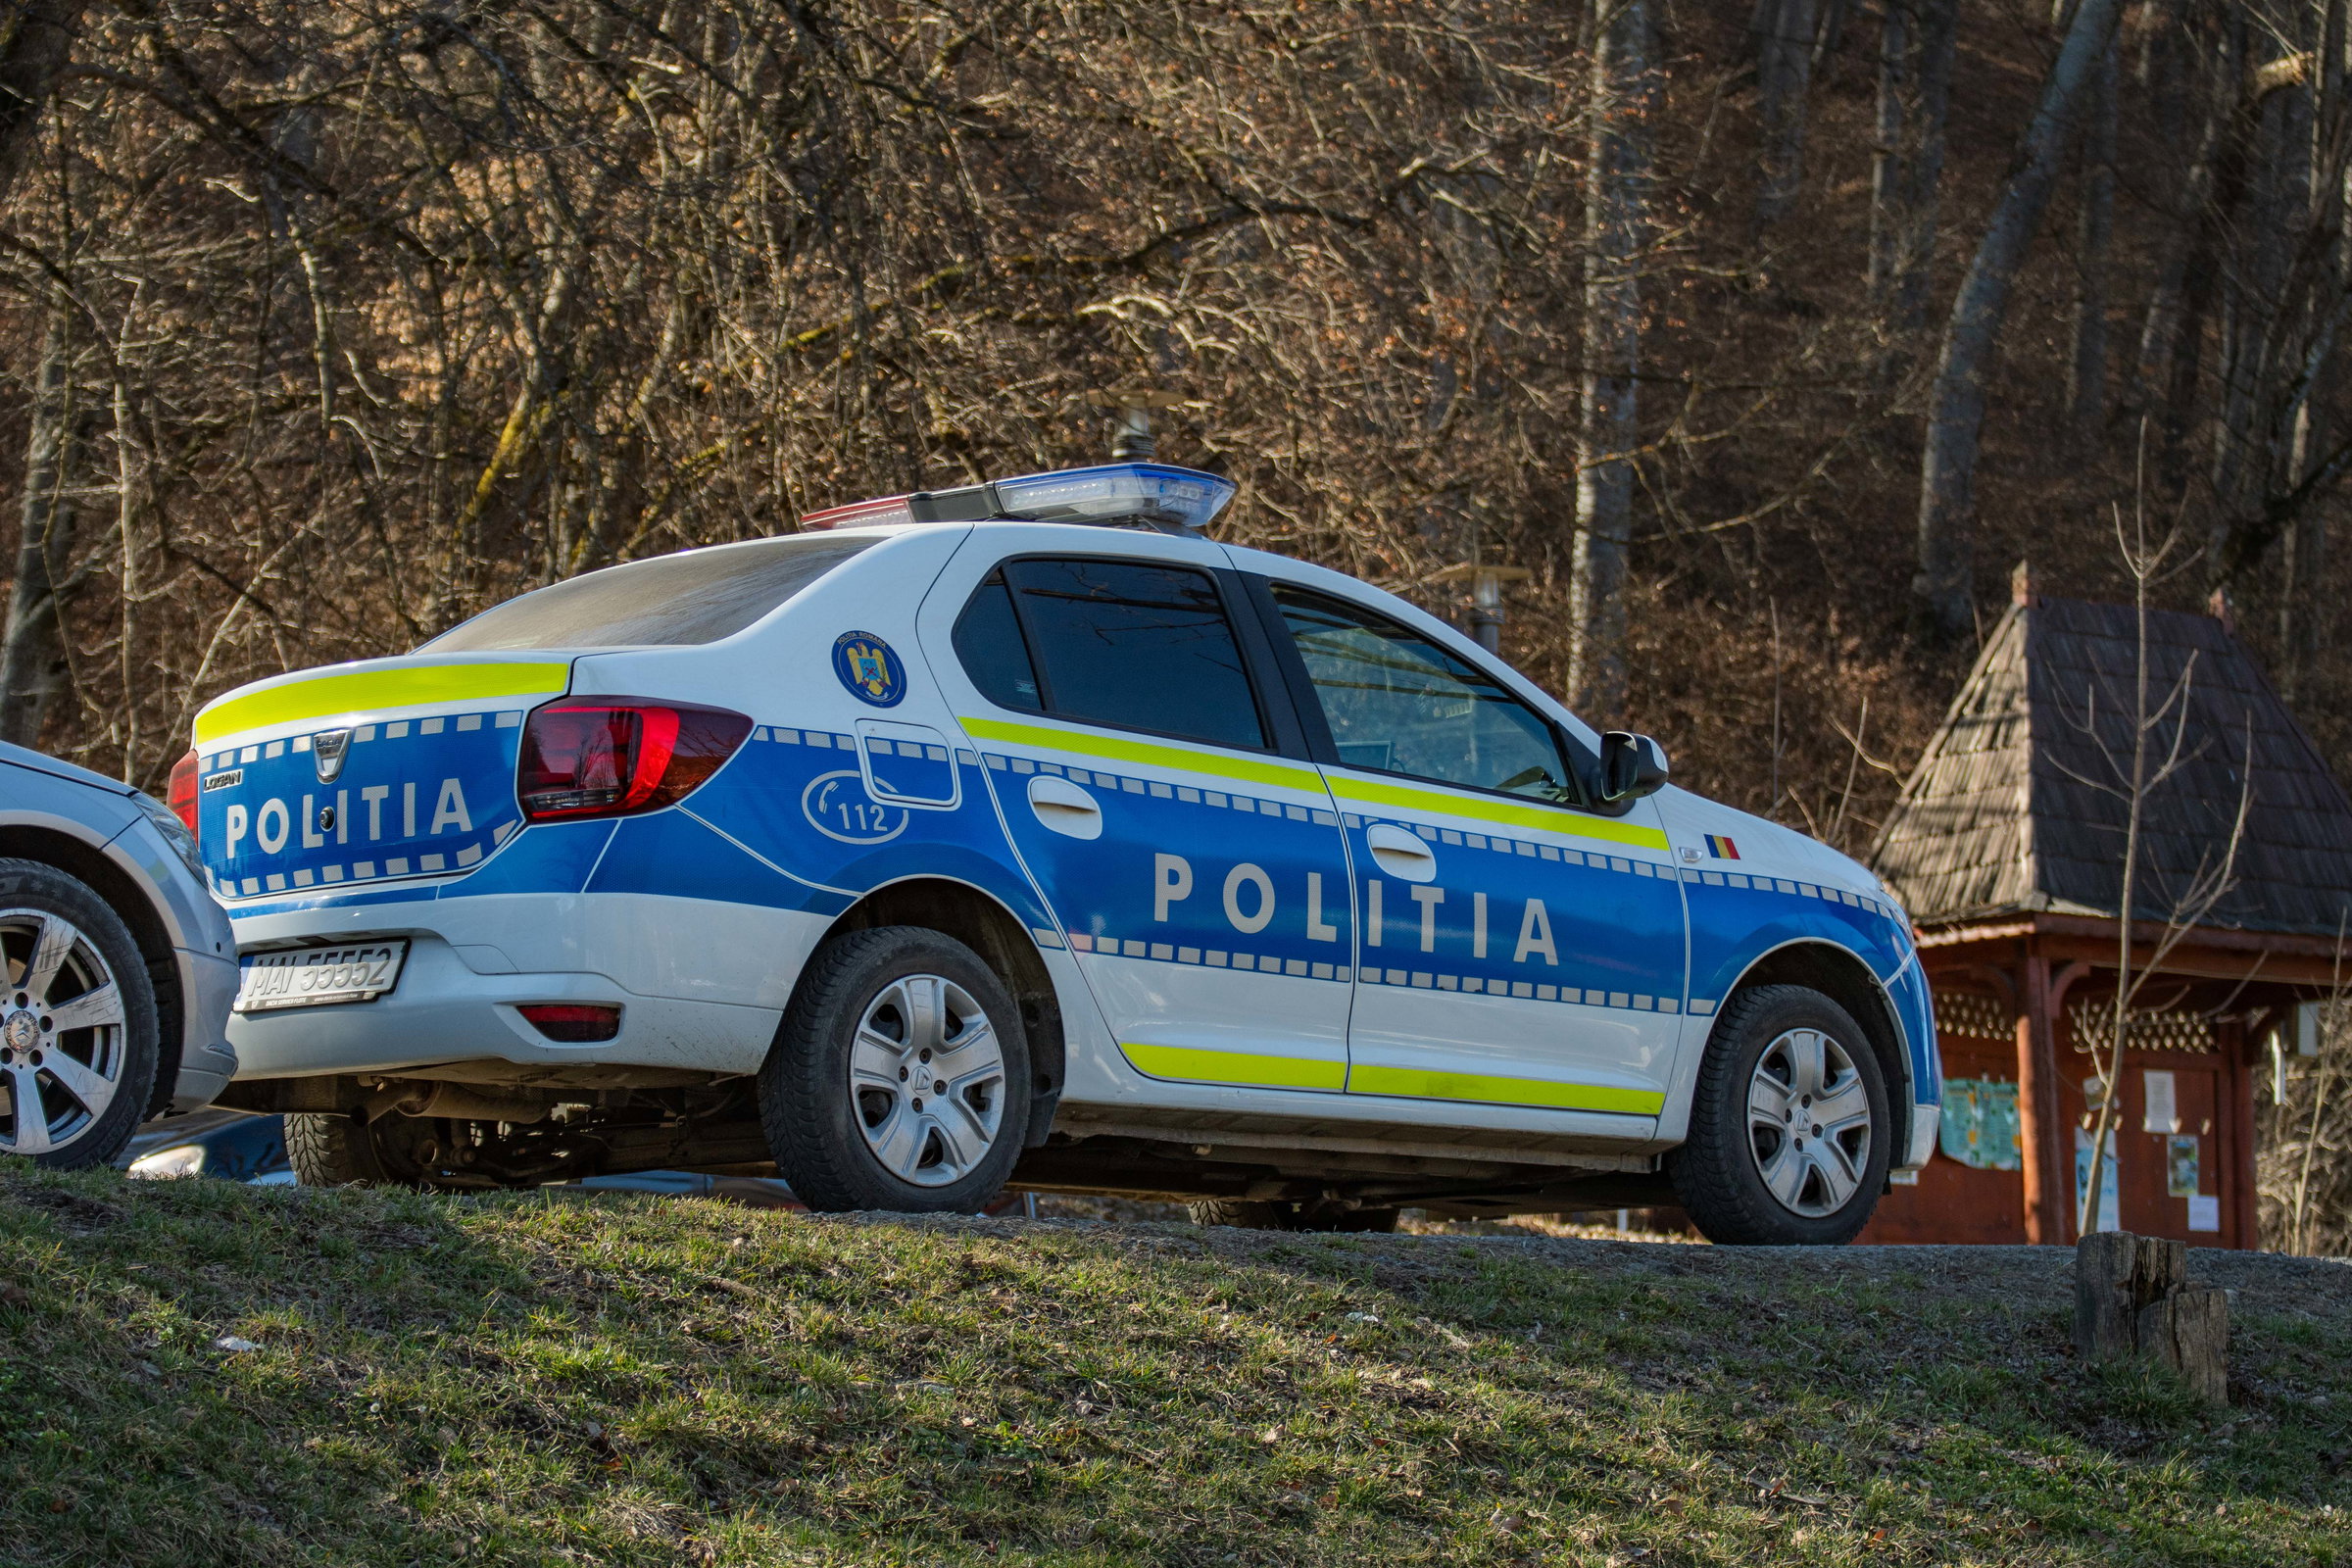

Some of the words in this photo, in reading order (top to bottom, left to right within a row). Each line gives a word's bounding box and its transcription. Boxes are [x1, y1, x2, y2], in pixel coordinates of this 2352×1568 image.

[204, 770, 242, 791] LOGAN
[226, 778, 473, 859] POLITIA
[838, 802, 888, 831] 112
[1153, 852, 1559, 966] POLITIA
[247, 956, 298, 997] MAI
[300, 948, 392, 991] 55552
